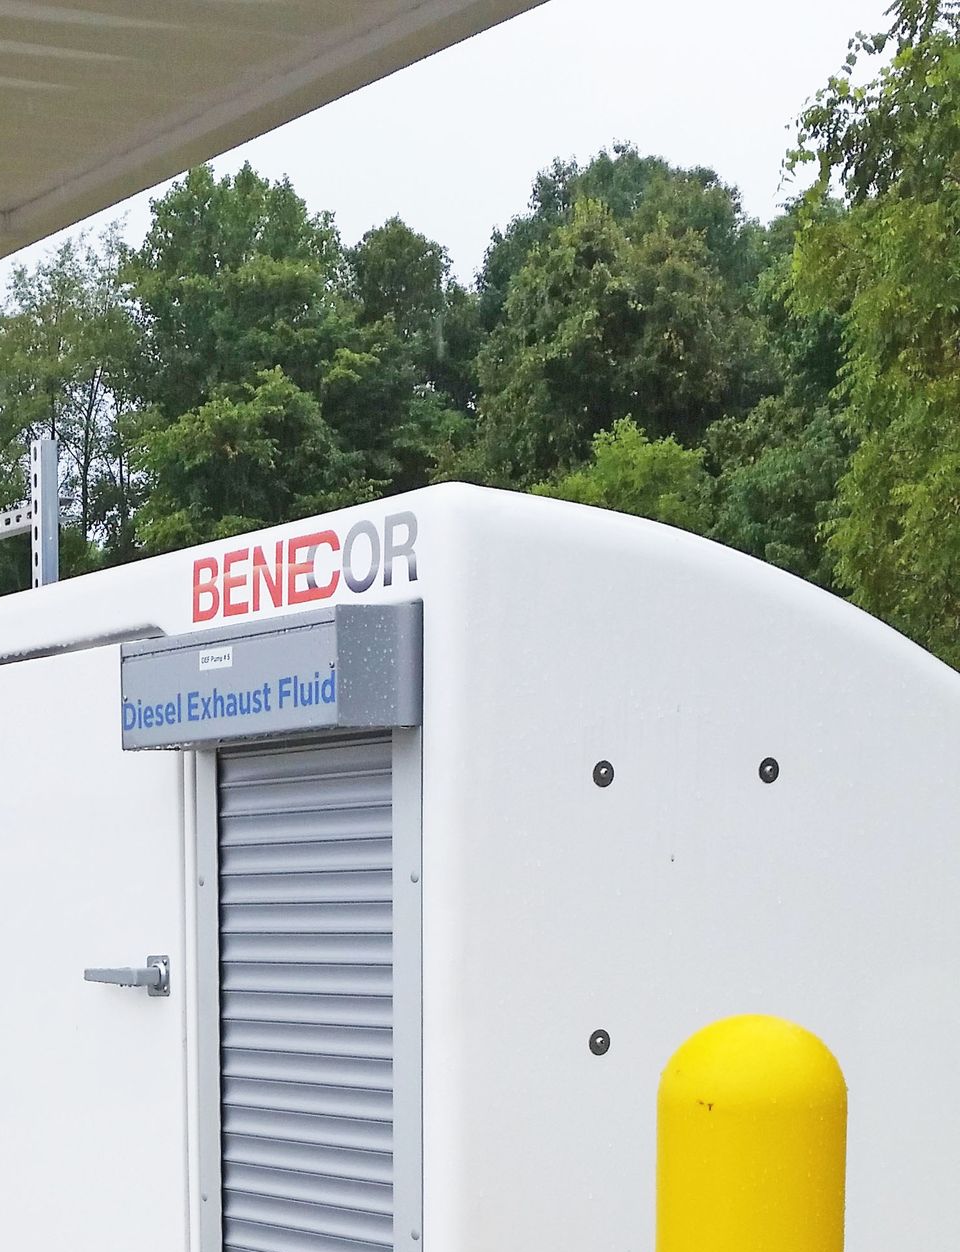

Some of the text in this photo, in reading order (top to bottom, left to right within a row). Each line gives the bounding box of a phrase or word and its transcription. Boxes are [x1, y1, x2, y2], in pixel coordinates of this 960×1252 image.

[192, 510, 419, 623] BENECOR
[123, 669, 337, 732] Diesel Exhaust Fluid
